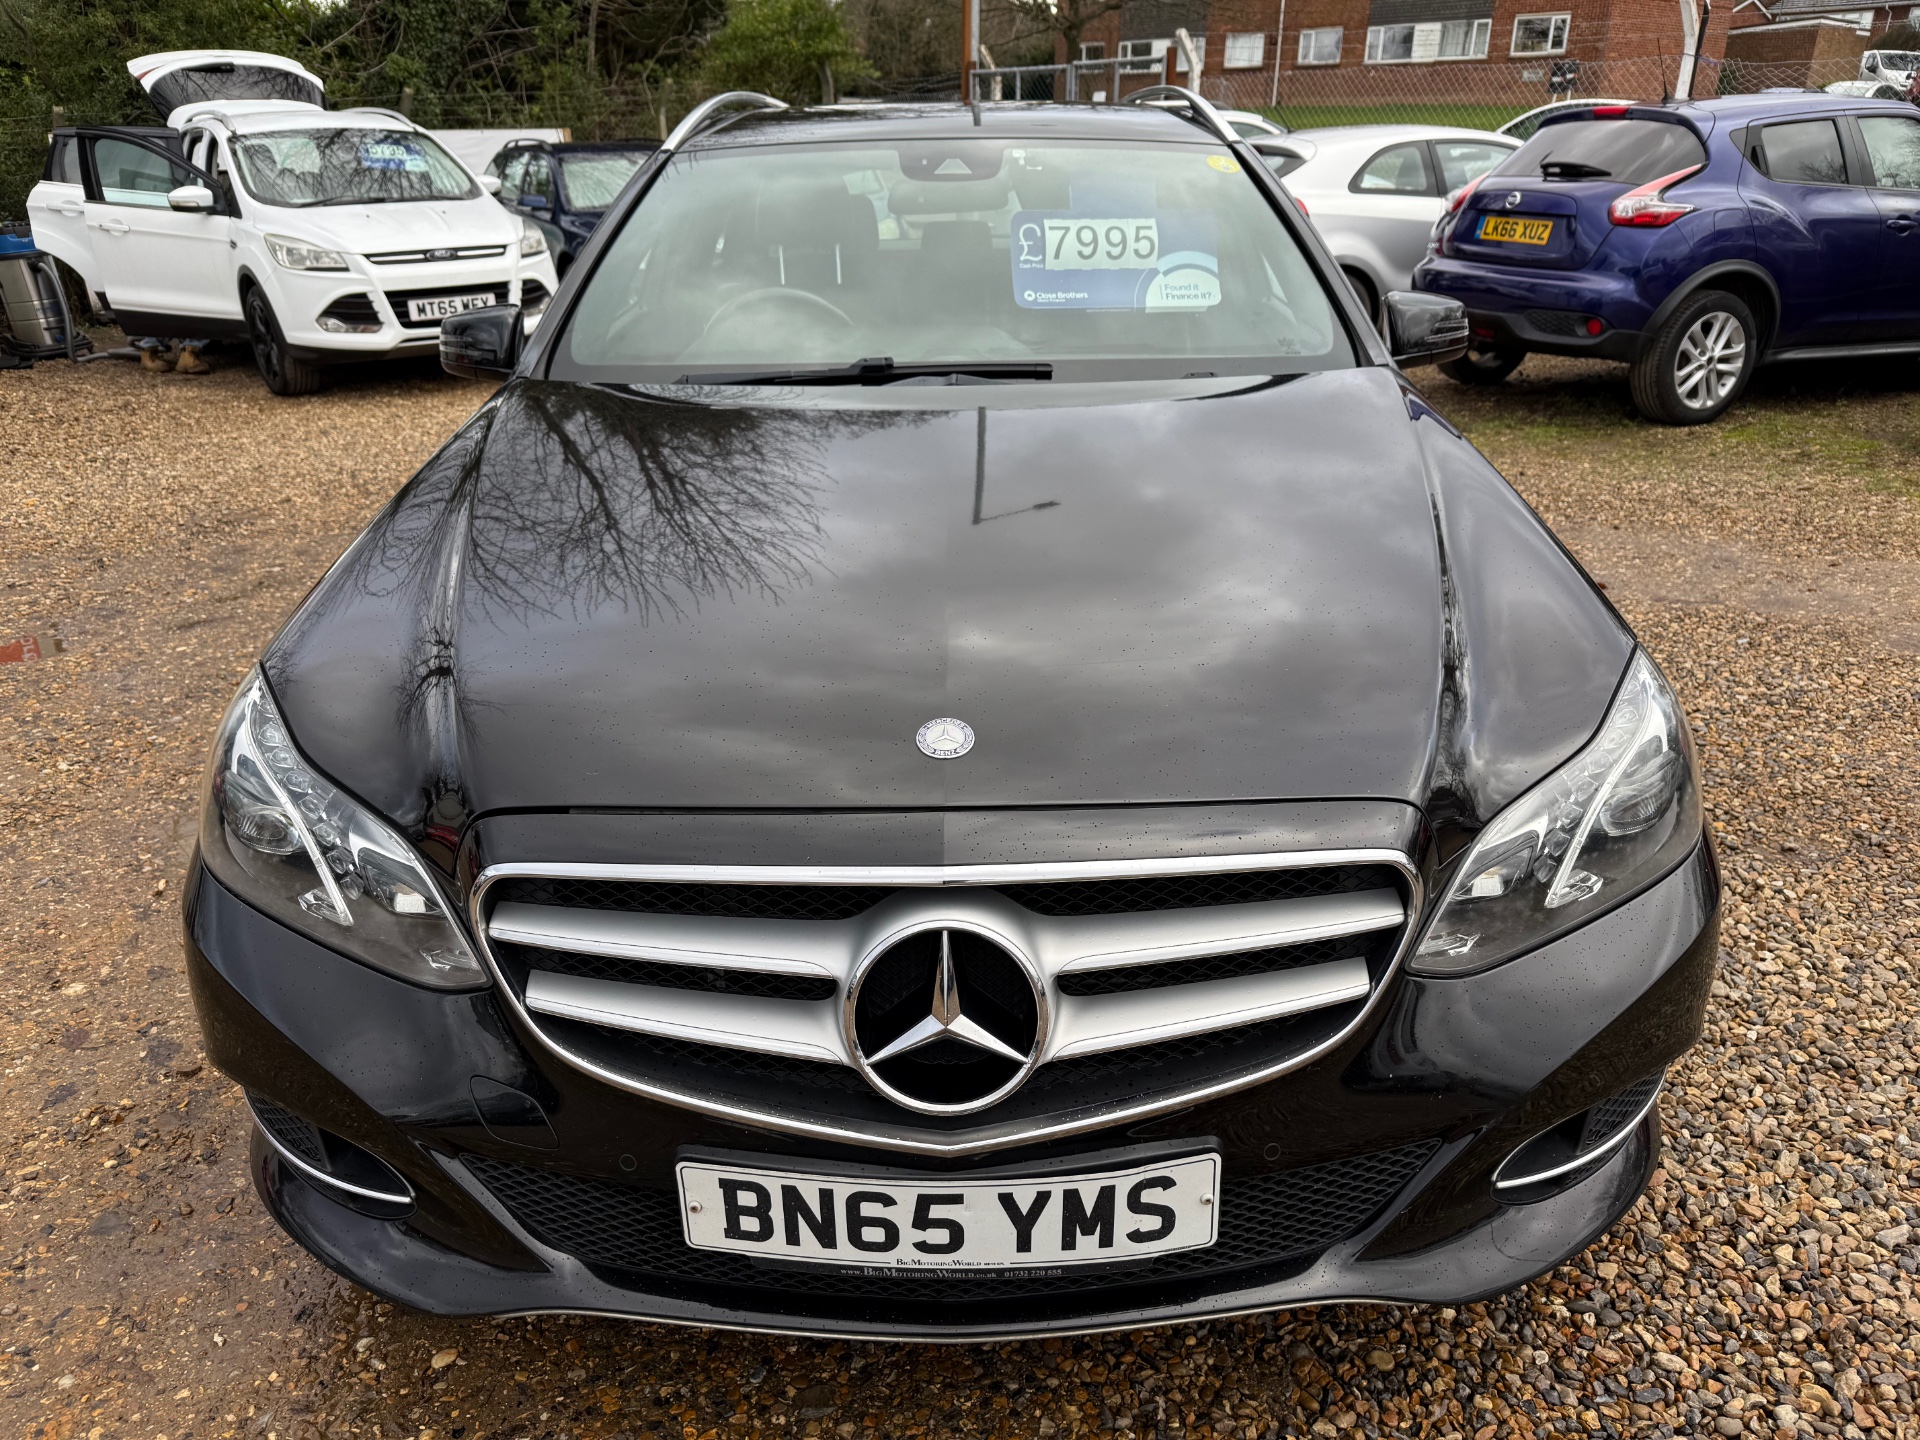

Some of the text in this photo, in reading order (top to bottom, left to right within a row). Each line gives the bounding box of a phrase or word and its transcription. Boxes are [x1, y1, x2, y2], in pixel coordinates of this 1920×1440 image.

[1483, 219, 1549, 241] LK66 XUZ
[1164, 283, 1199, 292] Found it
[1057, 291, 1089, 299] Brothers
[1165, 291, 1212, 300] Finance it?
[416, 300, 458, 318] MT65
[717, 1174, 1178, 1255] BN65 YMS
[1030, 1269, 1045, 1277] 220
[1047, 1268, 1062, 1276] 555
